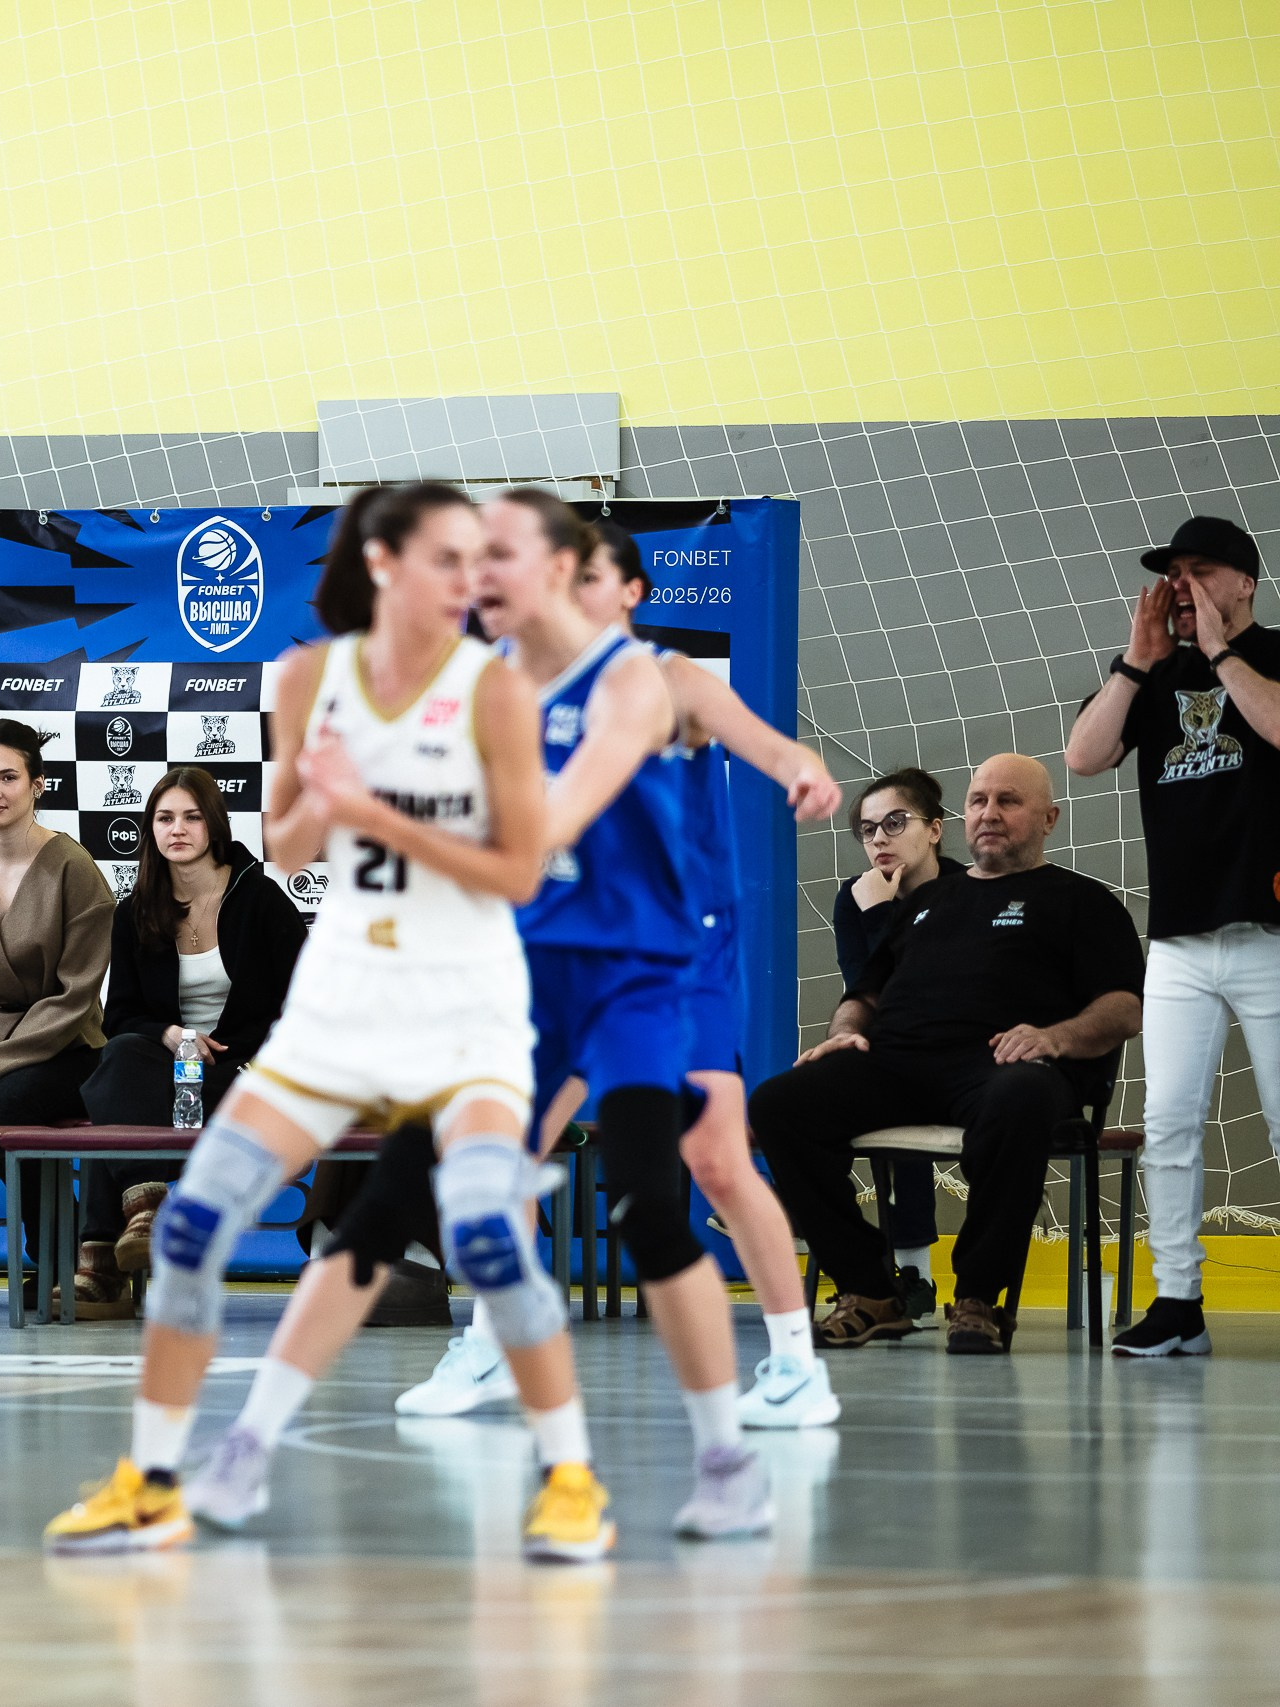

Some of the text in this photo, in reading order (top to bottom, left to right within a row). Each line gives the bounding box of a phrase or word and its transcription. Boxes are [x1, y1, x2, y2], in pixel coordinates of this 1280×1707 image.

[653, 550, 732, 567] FONBET
[198, 585, 245, 596] FONBET
[650, 586, 732, 605] 2025/26
[189, 600, 251, 622] ВЫСШАЯ
[209, 622, 230, 635] ЛИГА
[0, 677, 65, 692] FONBET
[184, 678, 247, 692] FONBET
[103, 697, 141, 707] ATLANTA
[196, 746, 235, 756] ATLANTA
[1165, 751, 1239, 779] ATLANTA
[214, 779, 247, 793] BET
[104, 796, 142, 806] ATLANTA
[111, 830, 138, 842] РФБ
[353, 837, 408, 893] 21
[302, 896, 323, 905] ЧГУ
